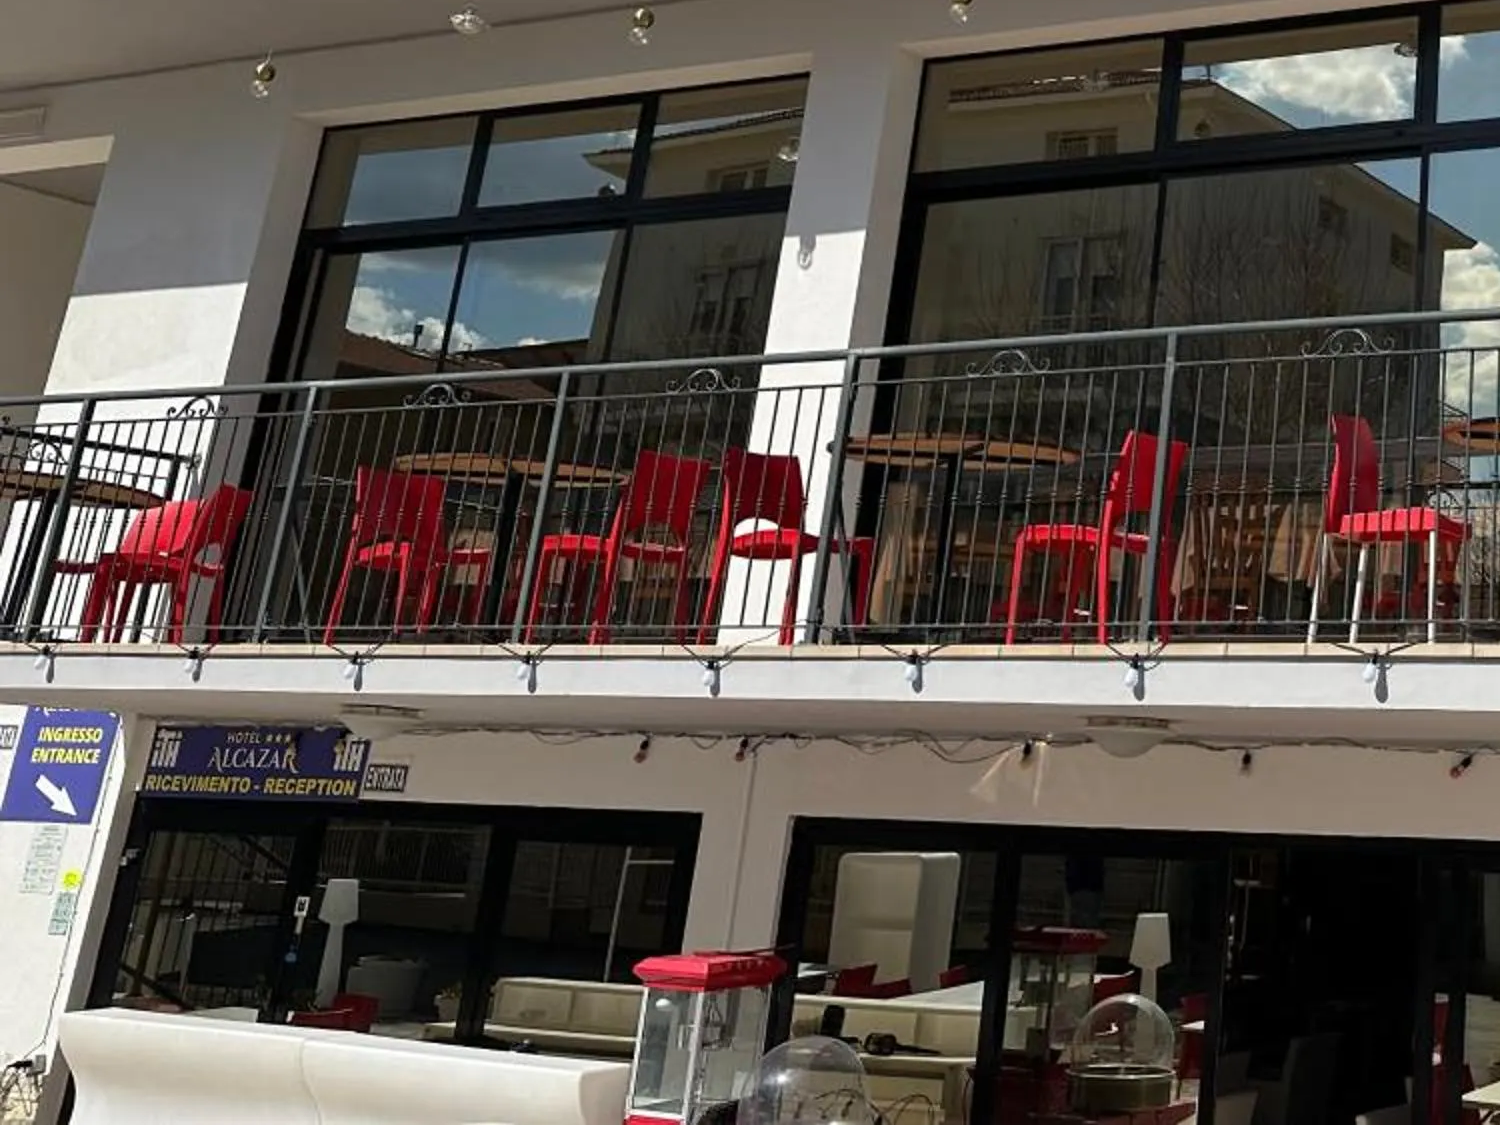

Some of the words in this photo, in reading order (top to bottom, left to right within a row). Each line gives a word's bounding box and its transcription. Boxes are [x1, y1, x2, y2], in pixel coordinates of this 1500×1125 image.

[39, 726, 103, 743] INGRESSO
[227, 732, 260, 744] HOTEL
[30, 747, 101, 764] ENTRANCE
[207, 746, 299, 774] ALCAZAR
[145, 775, 251, 793] RICEVIMENTO
[263, 777, 357, 795] RECEPTION
